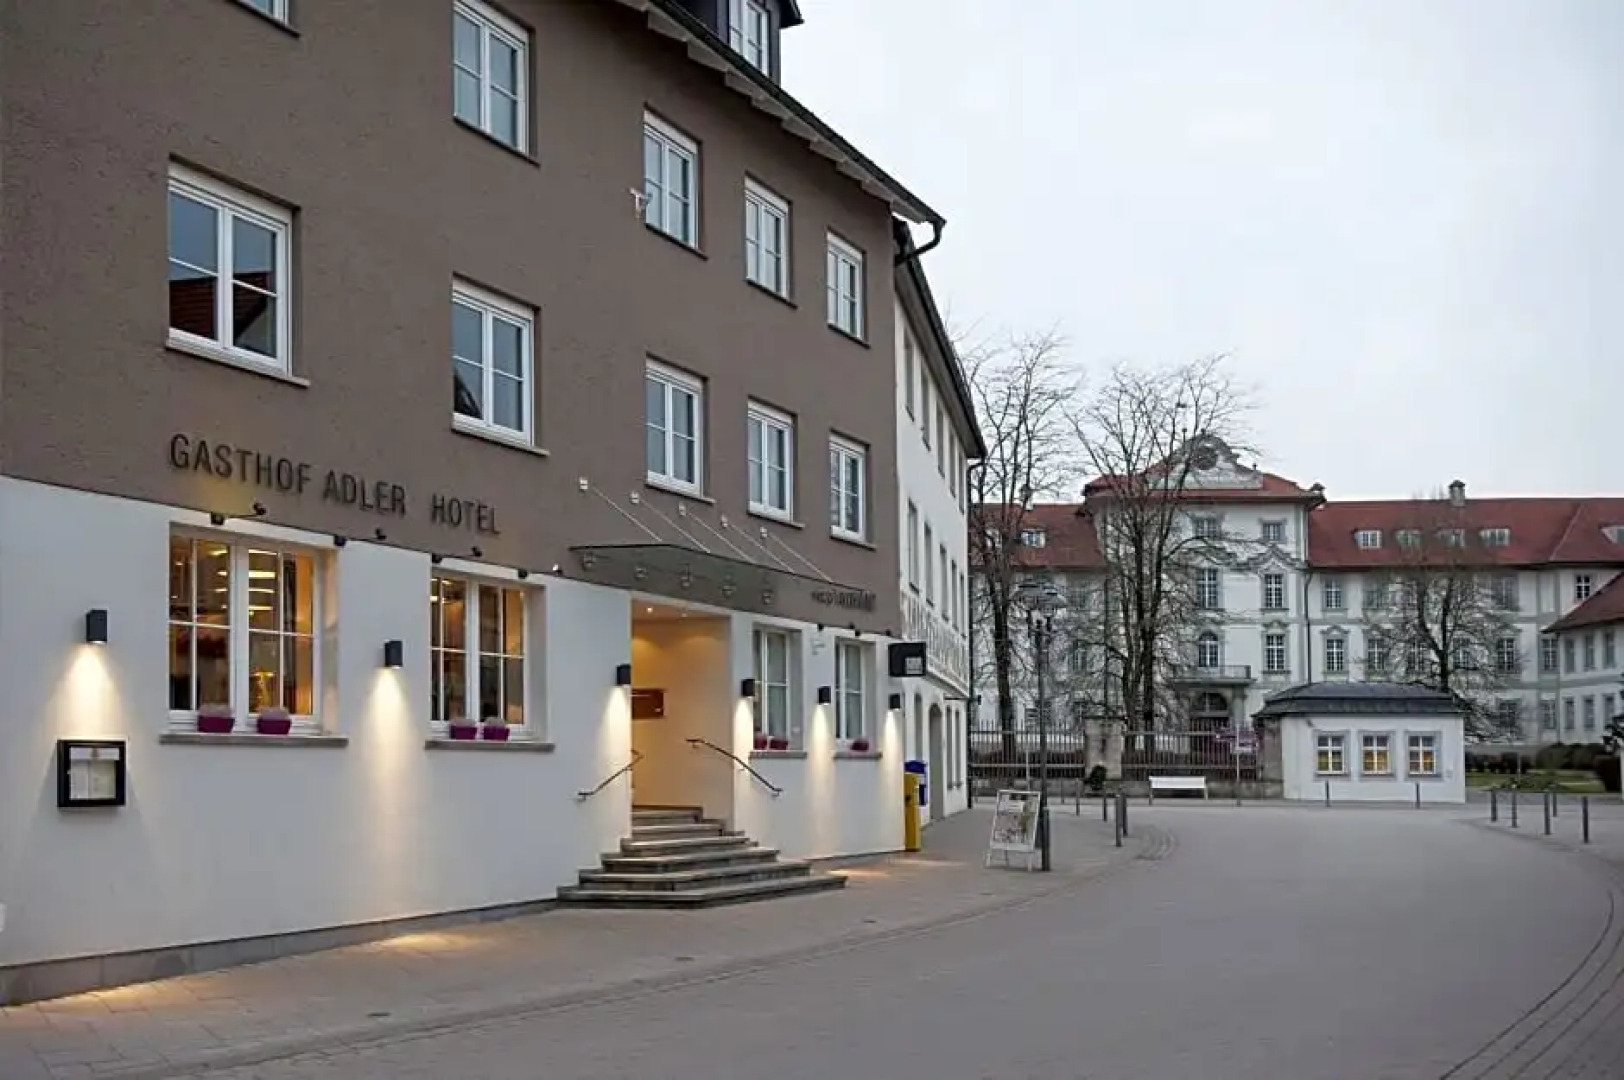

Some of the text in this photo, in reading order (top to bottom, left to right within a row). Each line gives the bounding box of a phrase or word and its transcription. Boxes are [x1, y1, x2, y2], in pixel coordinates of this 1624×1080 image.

[170, 433, 501, 535] GASTHOF ADLER HOTEL
